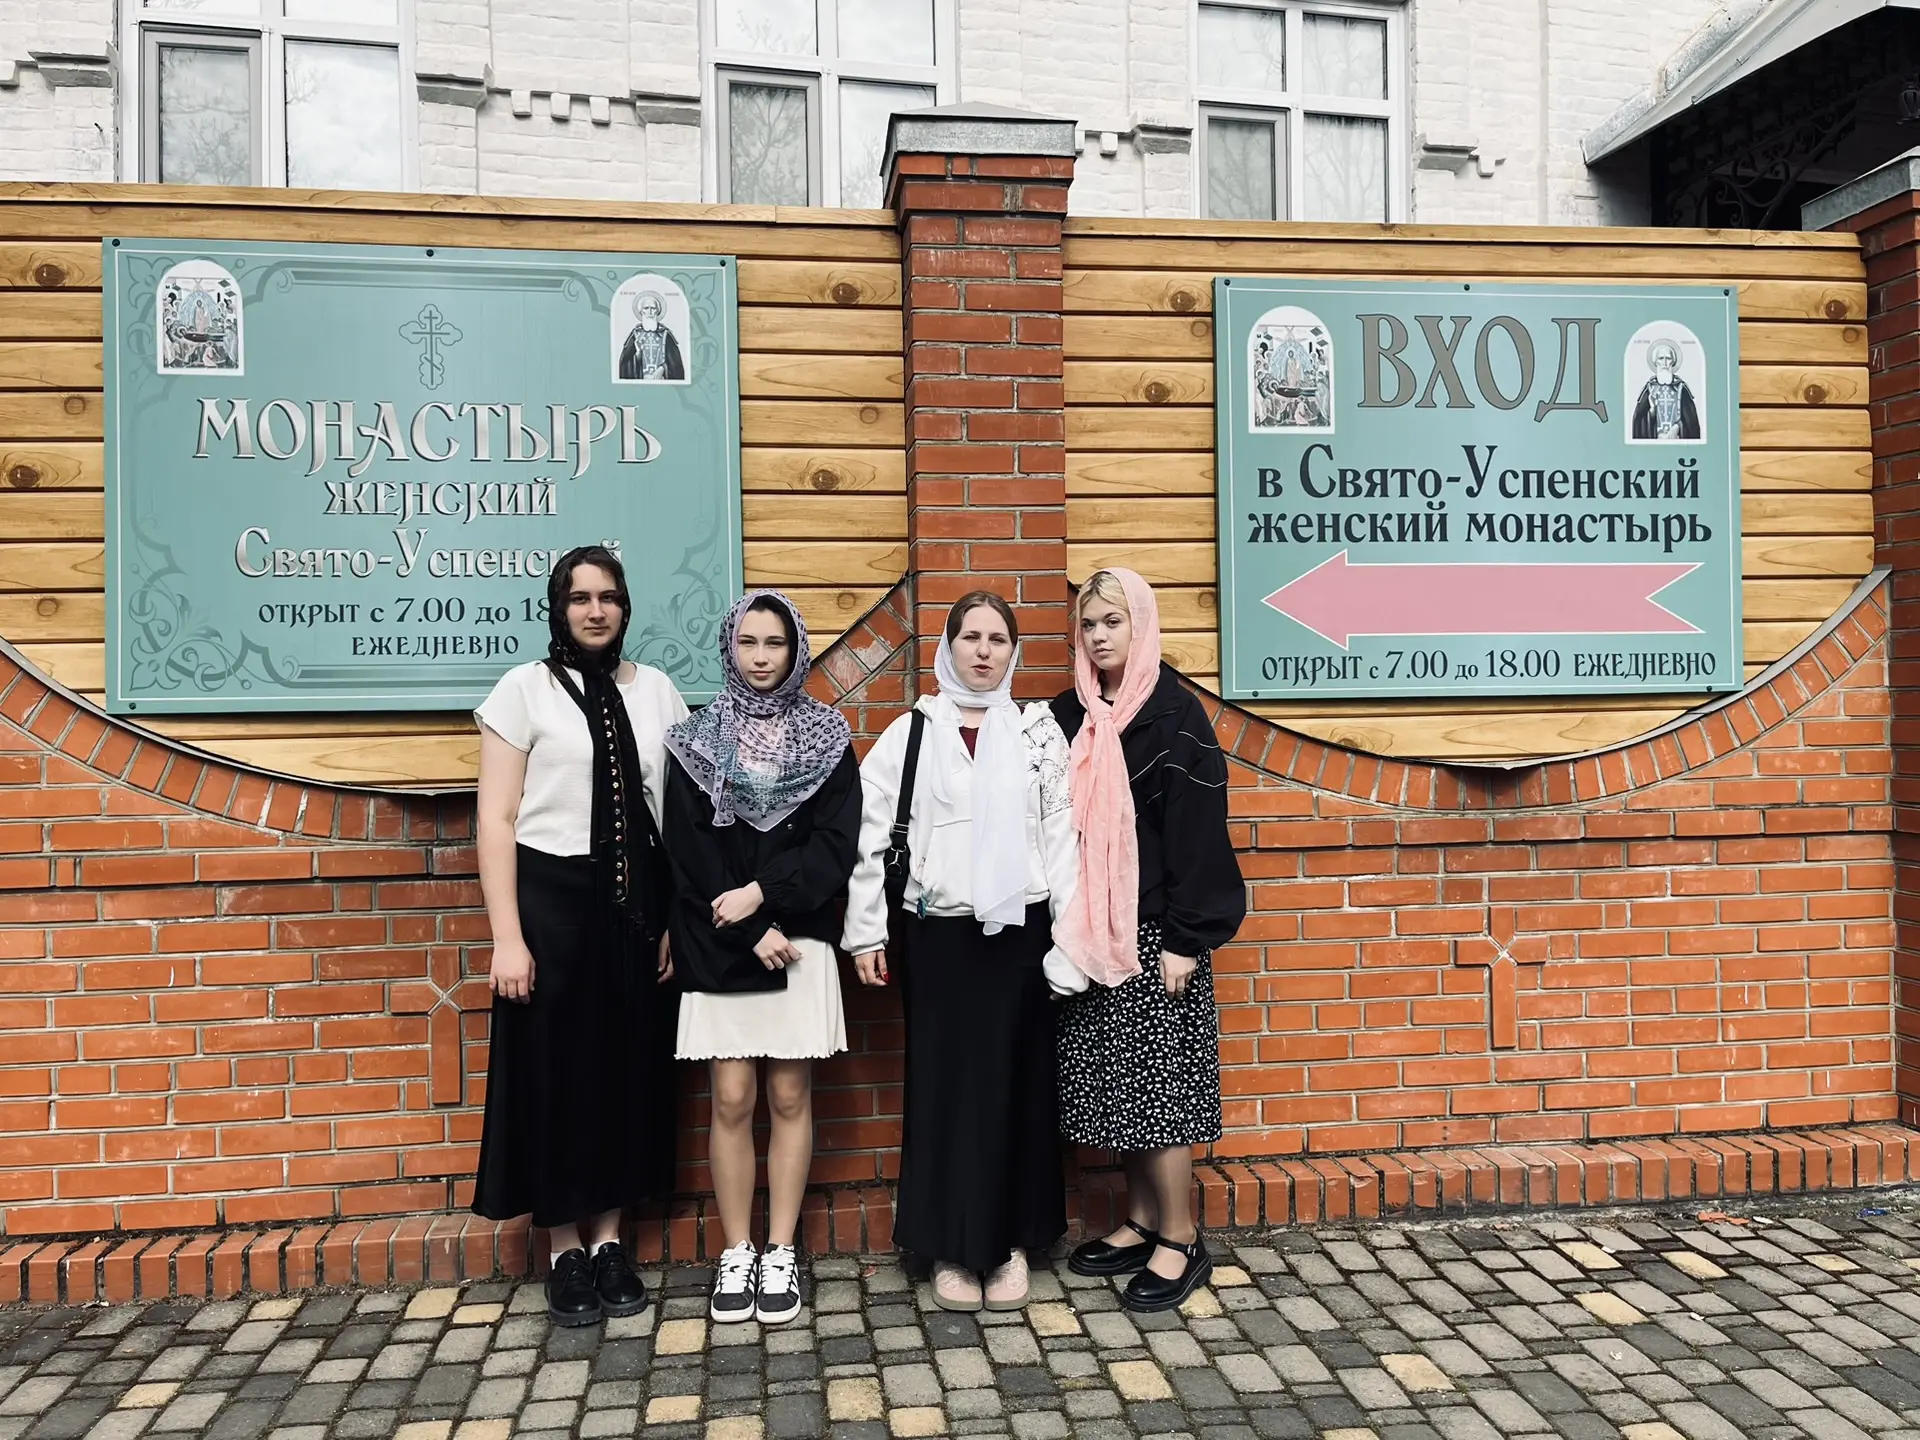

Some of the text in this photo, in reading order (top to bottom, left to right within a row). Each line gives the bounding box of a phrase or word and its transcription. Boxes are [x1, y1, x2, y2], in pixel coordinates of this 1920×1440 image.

[1356, 313, 1609, 423] ВХОД
[192, 397, 662, 480] МОНАСТЫРЬ
[1257, 443, 1701, 500] в Свято-Успенский
[322, 476, 559, 524] ЖЕНСКИЙ
[234, 526, 623, 578] Свято-Успенск
[1247, 500, 1712, 553] женский монастырь
[258, 603, 361, 628] ОТКРЫТ
[369, 606, 385, 623] с
[394, 597, 466, 623] 7.00
[474, 606, 511, 626] до
[351, 635, 520, 660] ЕЖЕДНЕВНО
[1261, 648, 1717, 687] ОТКРЫТ с 7.00 до 18.00 ЕЖЕДНЕВНО
